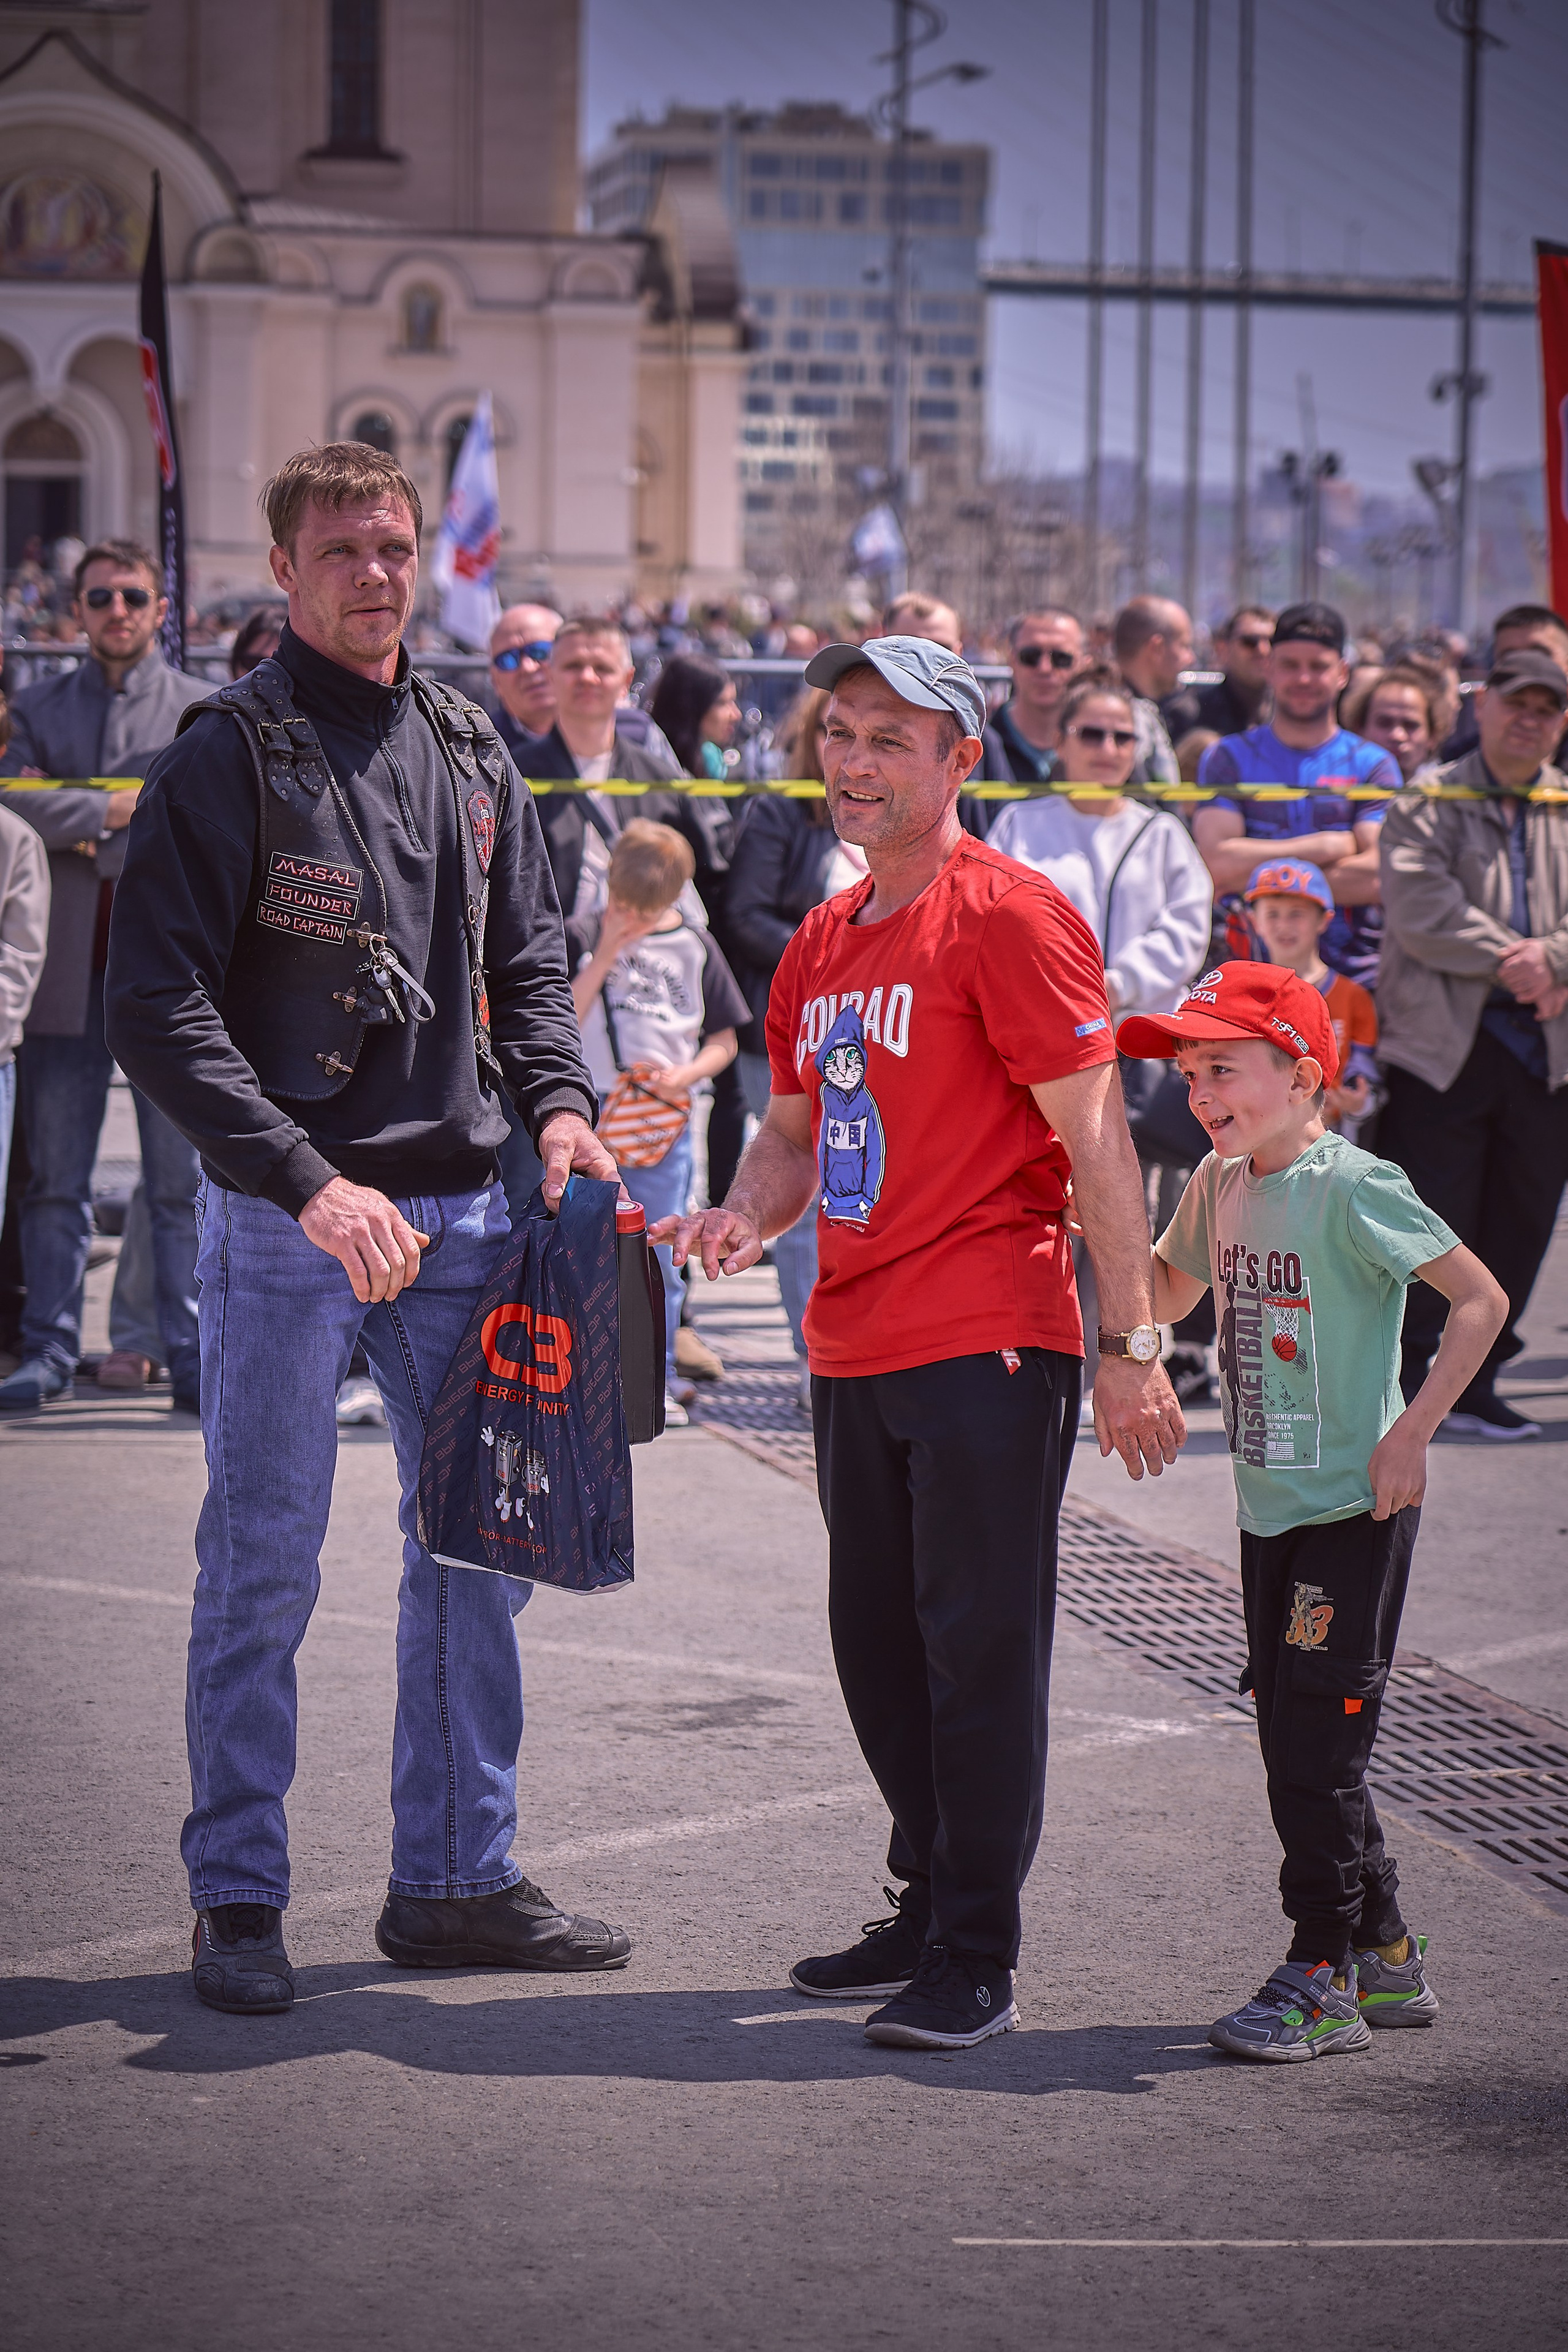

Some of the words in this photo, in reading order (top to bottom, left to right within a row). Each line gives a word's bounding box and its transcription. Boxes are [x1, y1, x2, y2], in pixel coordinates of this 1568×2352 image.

[275, 859, 356, 887] MASAL
[268, 883, 352, 916] FOUNDER
[260, 906, 290, 926] ROAD
[293, 917, 343, 940] CAPTAIN
[1085, 1020, 1100, 1030] CHINA
[1266, 1249, 1302, 1295] GO
[476, 1380, 524, 1404] ENERGY
[1236, 1285, 1268, 1469] BASKETBALL
